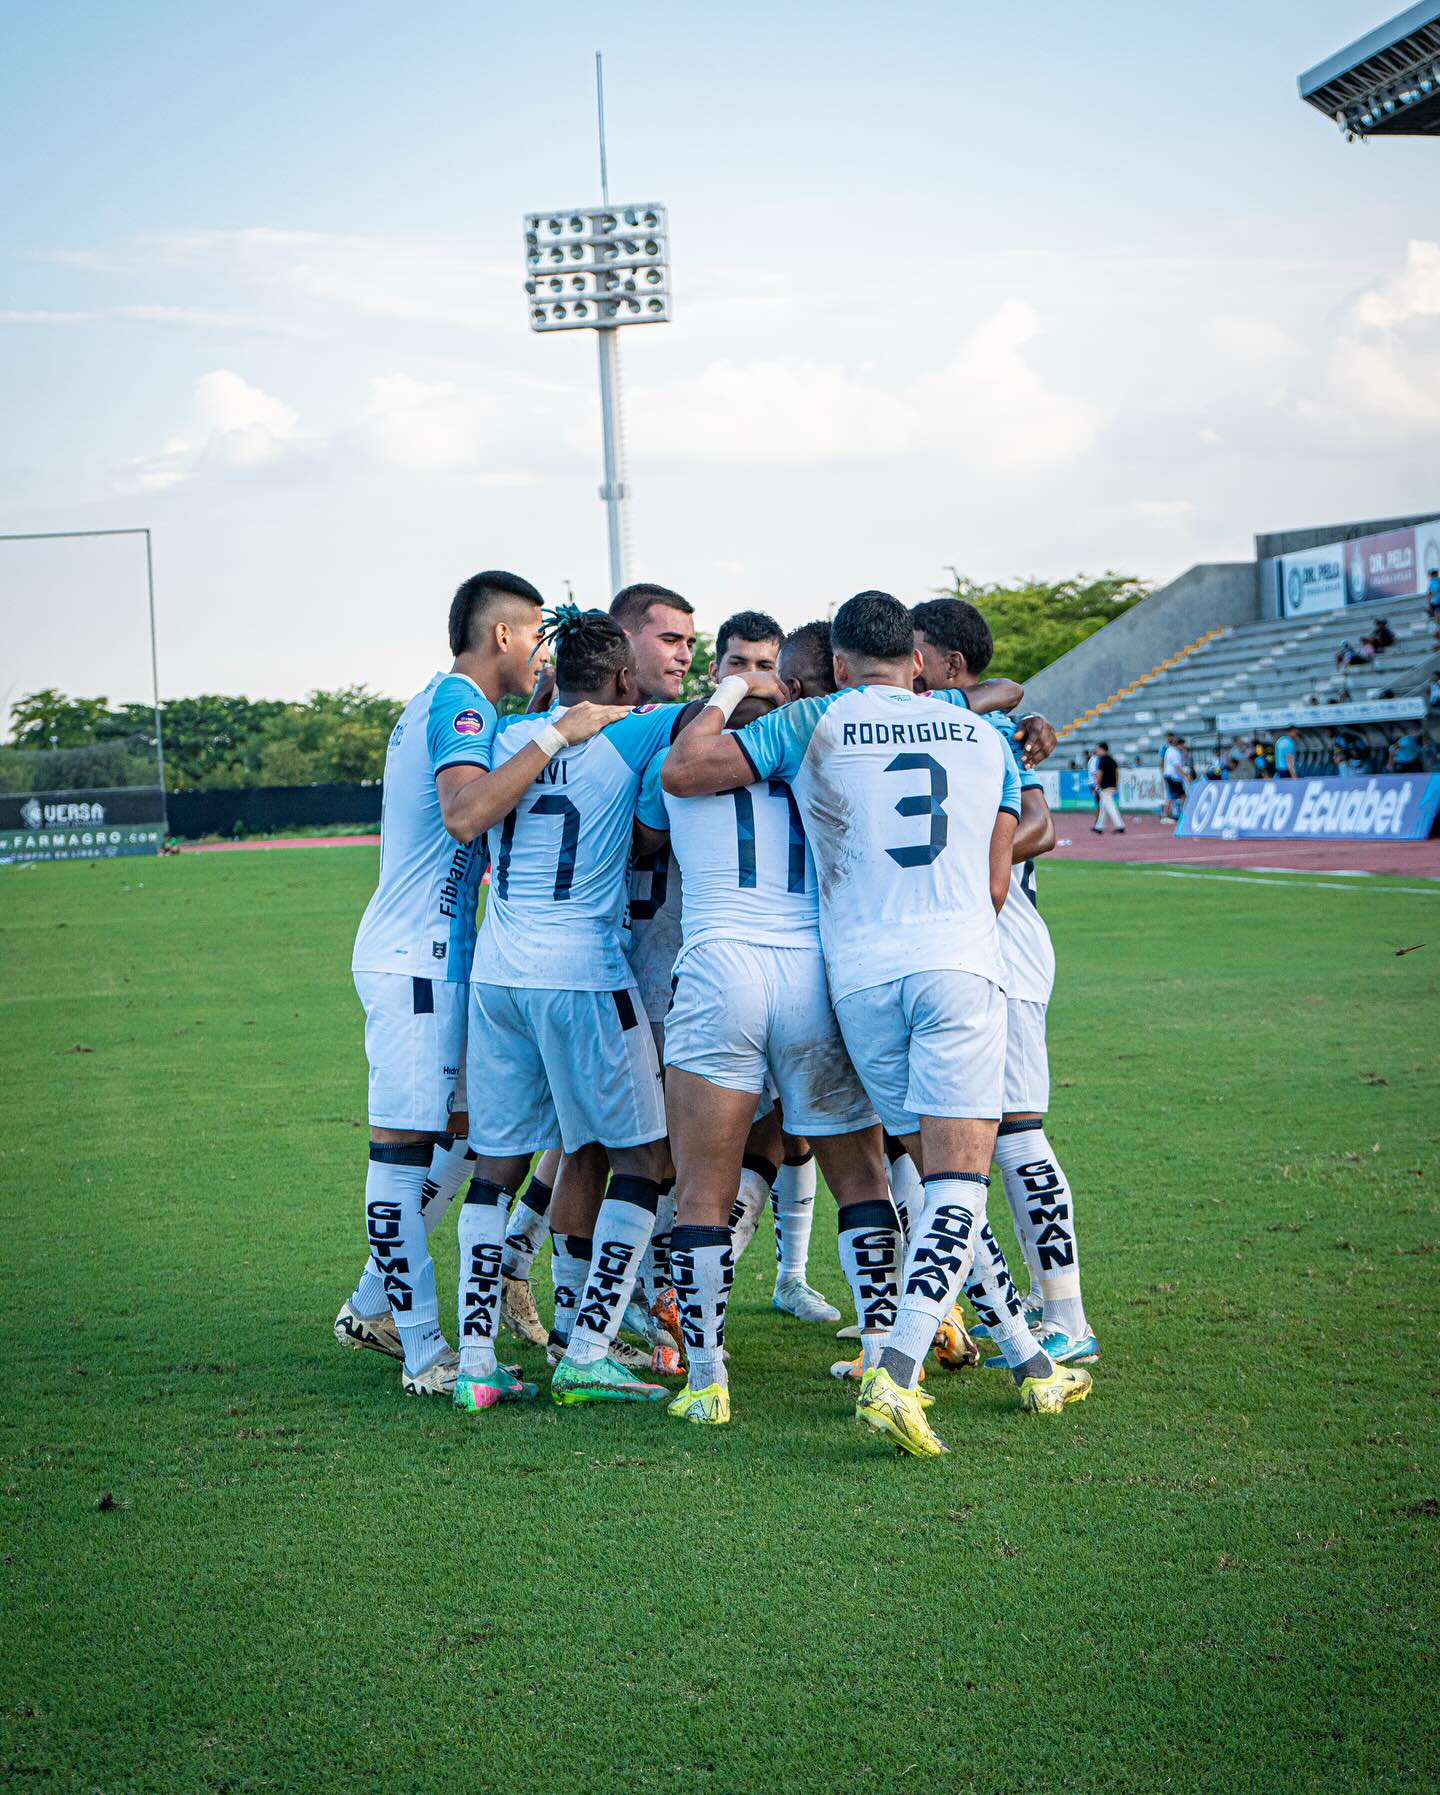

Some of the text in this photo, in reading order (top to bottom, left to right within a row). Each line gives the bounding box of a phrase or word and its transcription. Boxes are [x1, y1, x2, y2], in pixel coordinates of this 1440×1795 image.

[843, 721, 978, 746] RODRIGUEZ
[716, 780, 806, 895] 11
[884, 753, 949, 869] 3
[1211, 780, 1294, 831] LigaPro
[1293, 778, 1413, 834] Ecuabet
[367, 1200, 414, 1312] GUTMAN
[905, 1205, 975, 1303] GUTMAN
[1016, 1159, 1075, 1270] GUTMAN
[463, 1243, 504, 1337] GUTMAN
[576, 1241, 636, 1333] GUTMAN
[852, 1229, 898, 1328] GUTMAN
